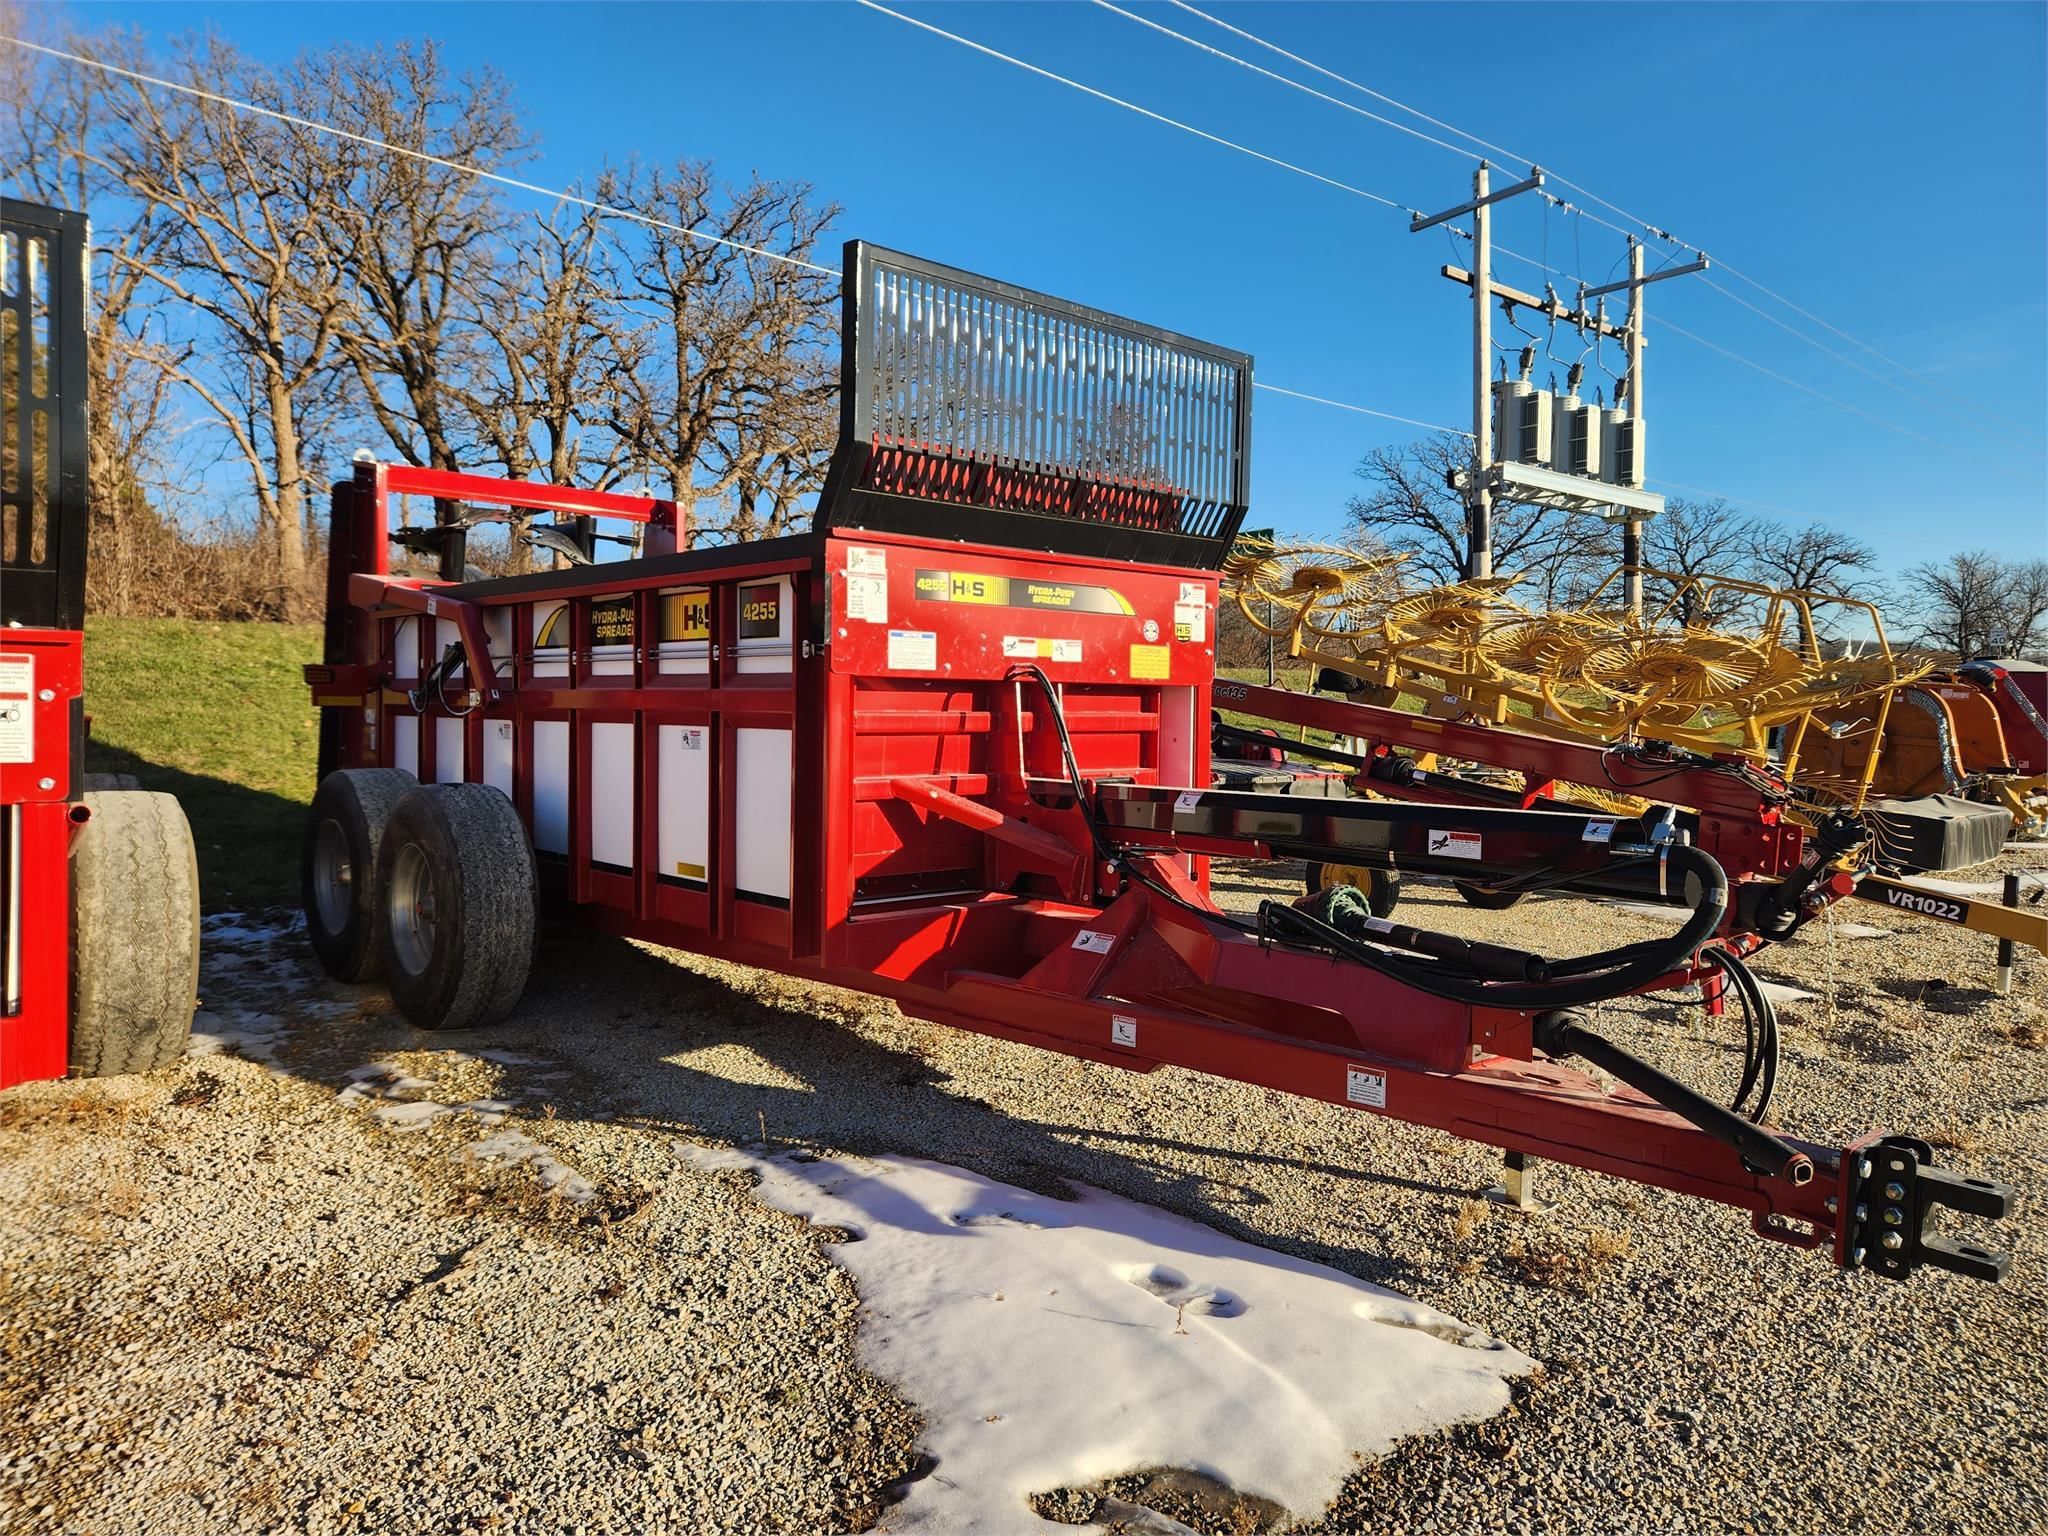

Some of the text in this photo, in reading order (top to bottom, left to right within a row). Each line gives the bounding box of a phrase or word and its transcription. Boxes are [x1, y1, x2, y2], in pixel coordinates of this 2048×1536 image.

[916, 578, 984, 597] 4255 H&S
[743, 602, 776, 621] 4255
[1888, 889, 1960, 920] VR1022
